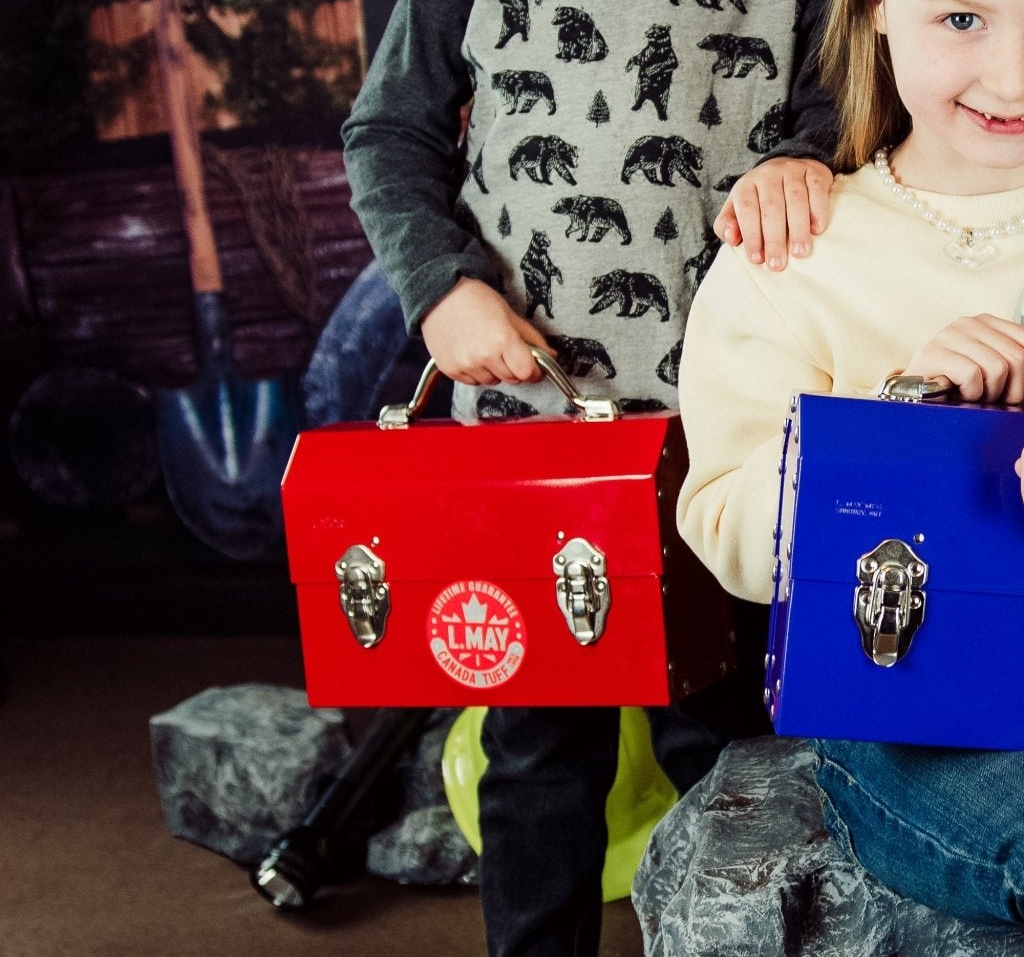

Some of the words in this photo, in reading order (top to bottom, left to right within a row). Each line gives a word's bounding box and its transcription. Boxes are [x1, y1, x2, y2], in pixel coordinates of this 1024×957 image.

[431, 582, 466, 615] LIFETIME
[468, 581, 519, 619] GUARANTEE
[437, 651, 476, 685] CANADA
[483, 665, 509, 685] TUFF
